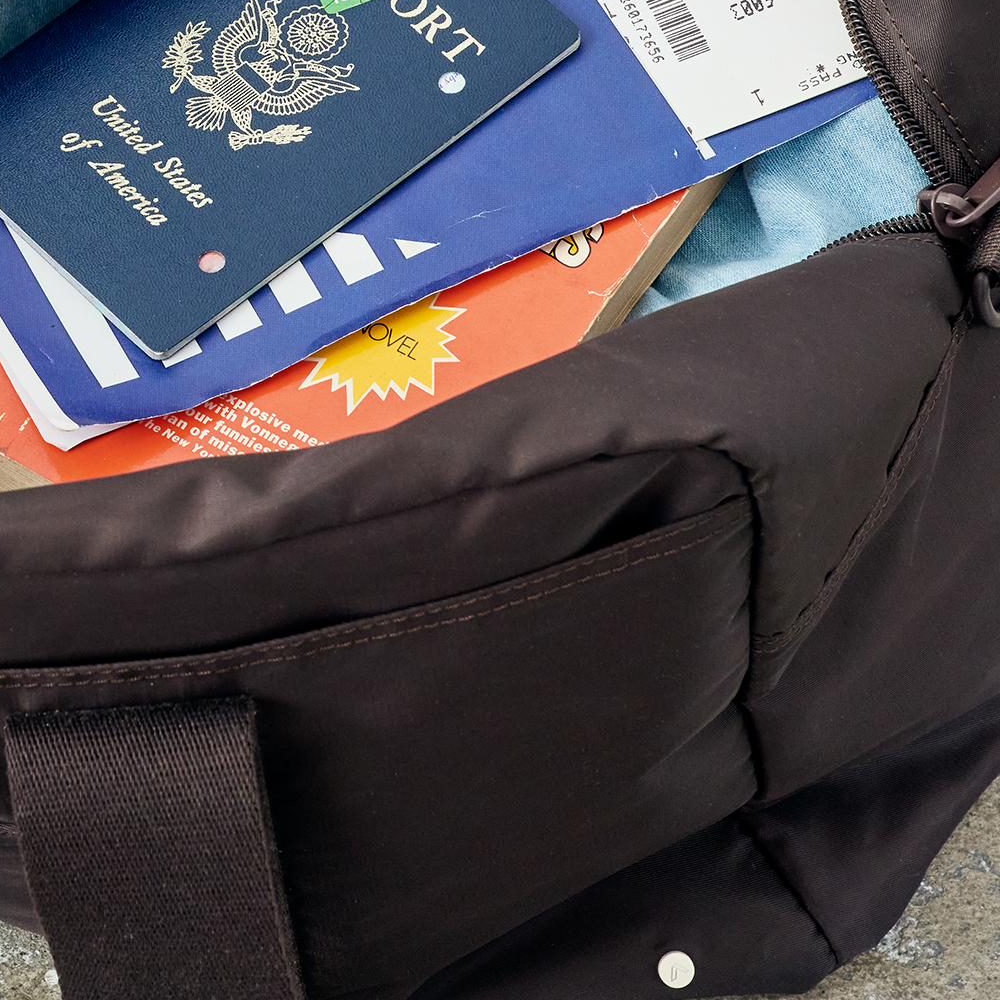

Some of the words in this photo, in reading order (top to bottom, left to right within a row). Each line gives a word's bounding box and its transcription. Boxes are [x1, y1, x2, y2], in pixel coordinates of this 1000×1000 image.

[798, 67, 842, 92] PASS
[92, 94, 164, 154] United
[152, 157, 213, 208] States
[60, 132, 103, 152] of
[87, 161, 168, 226] America
[204, 400, 238, 422] with
[219, 393, 292, 433] explosive
[161, 428, 191, 448] New
[189, 425, 210, 440] of
[213, 420, 279, 454] funnies
